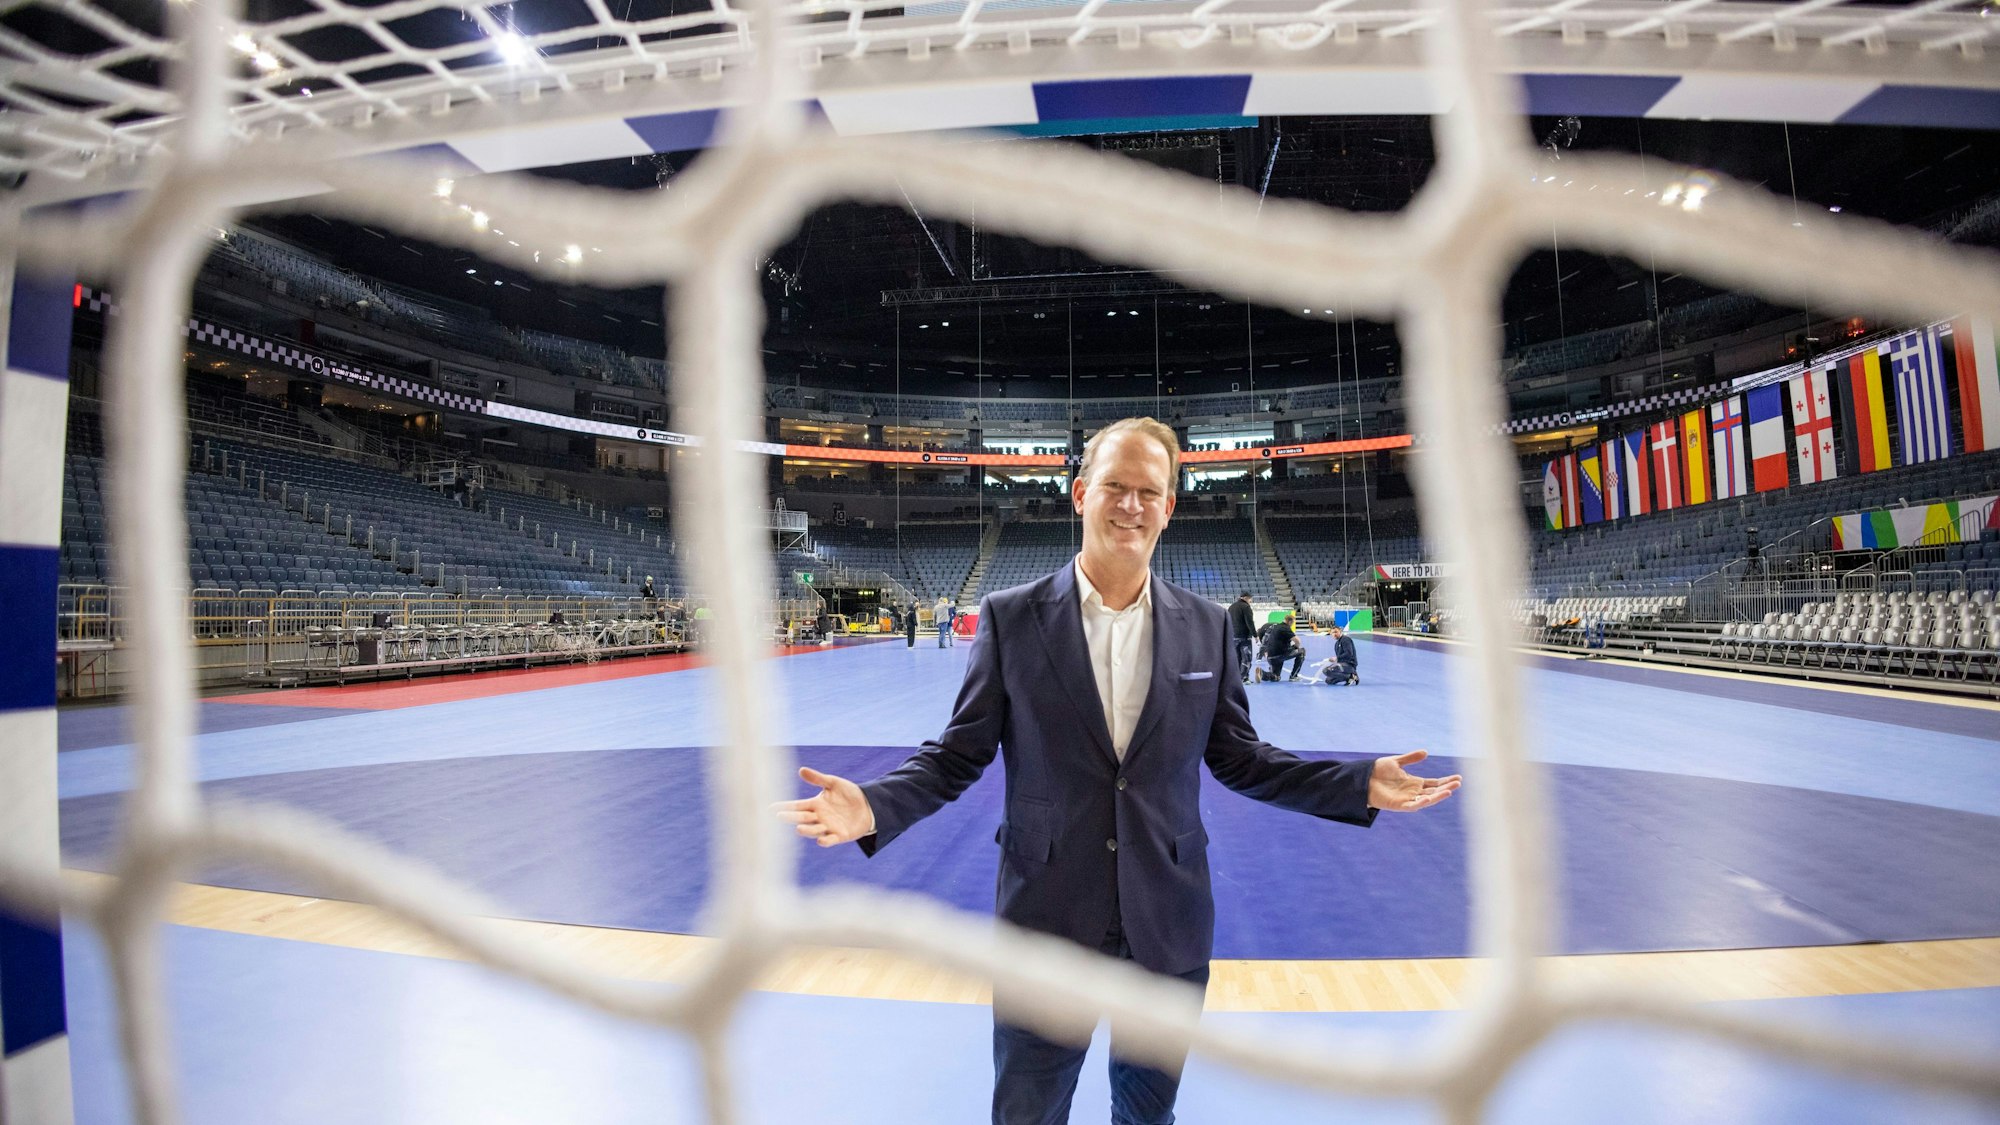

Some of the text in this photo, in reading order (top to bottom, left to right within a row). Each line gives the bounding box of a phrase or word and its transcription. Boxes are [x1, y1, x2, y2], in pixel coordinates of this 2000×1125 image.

[1392, 565, 1444, 578] HERE TO PLAY
